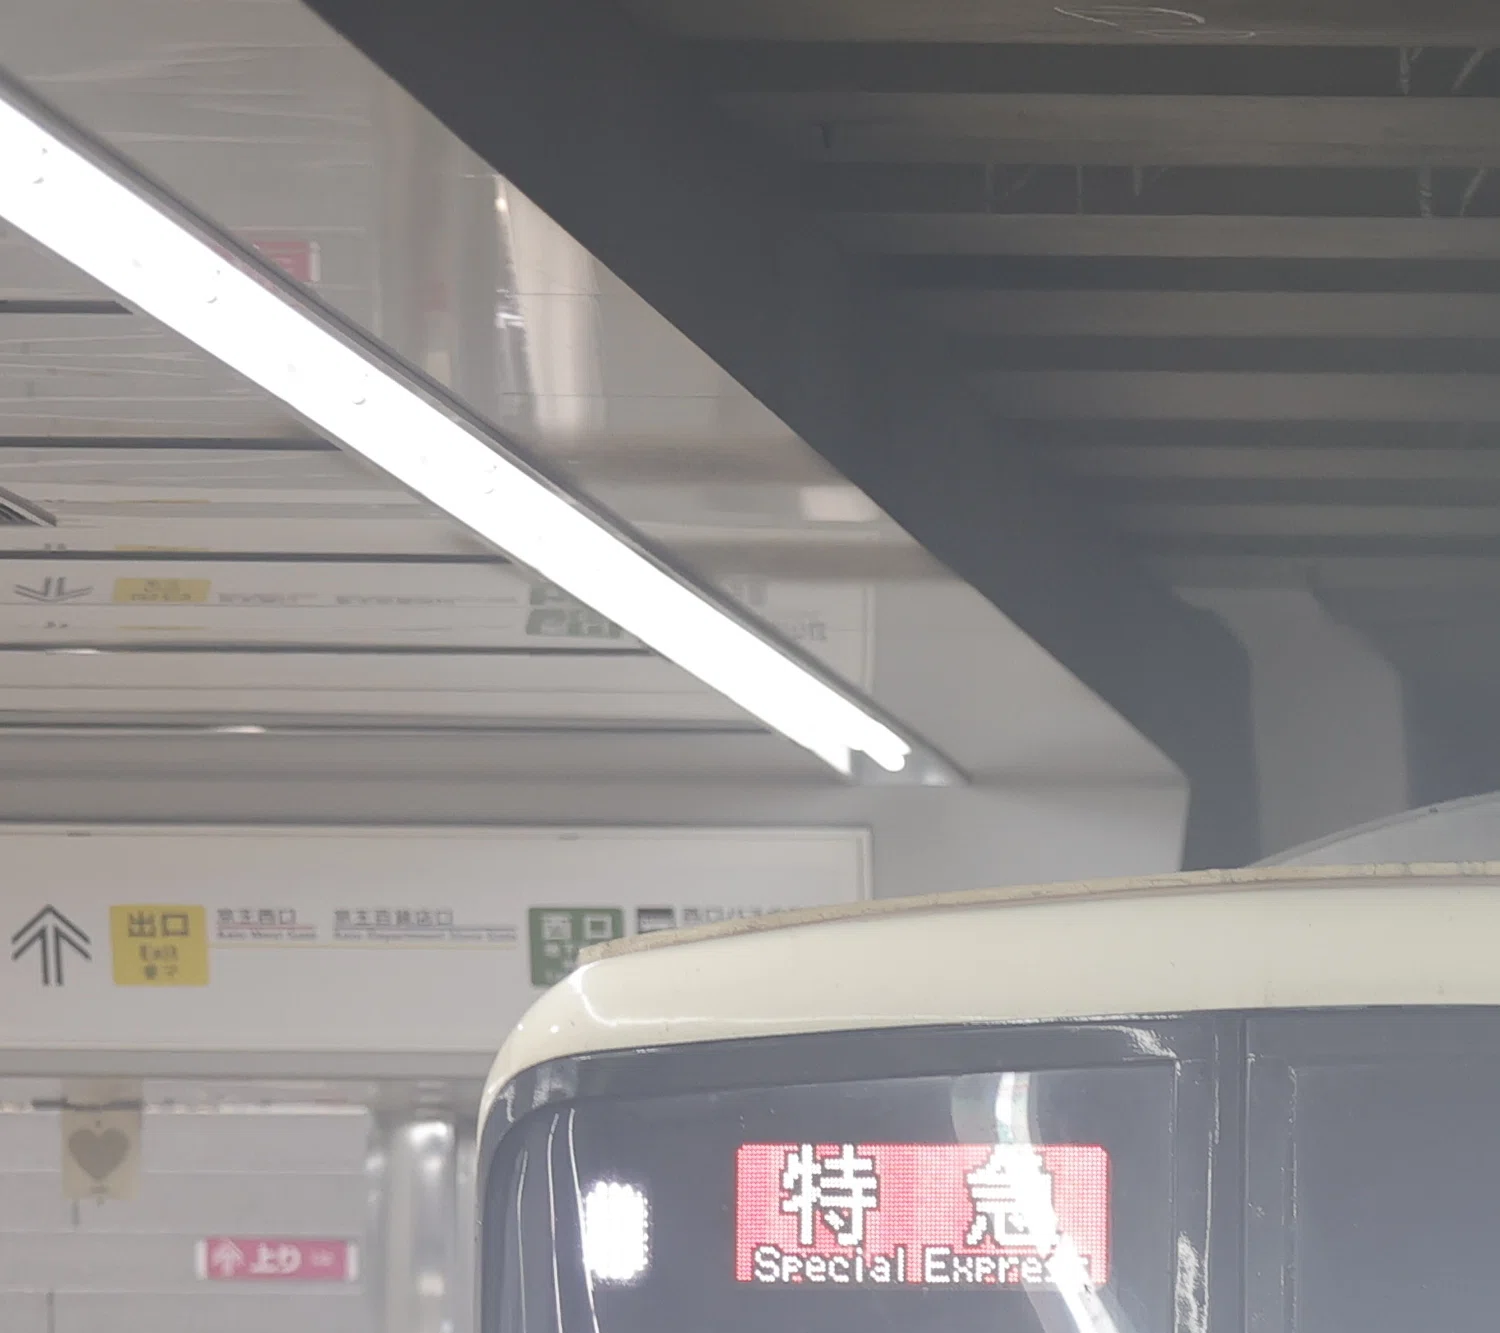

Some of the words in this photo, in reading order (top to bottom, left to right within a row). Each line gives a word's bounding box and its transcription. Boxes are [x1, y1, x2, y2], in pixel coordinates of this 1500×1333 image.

[127, 910, 190, 939] 出口
[754, 1246, 905, 1284] Special
[925, 1246, 1088, 1284] Expre
